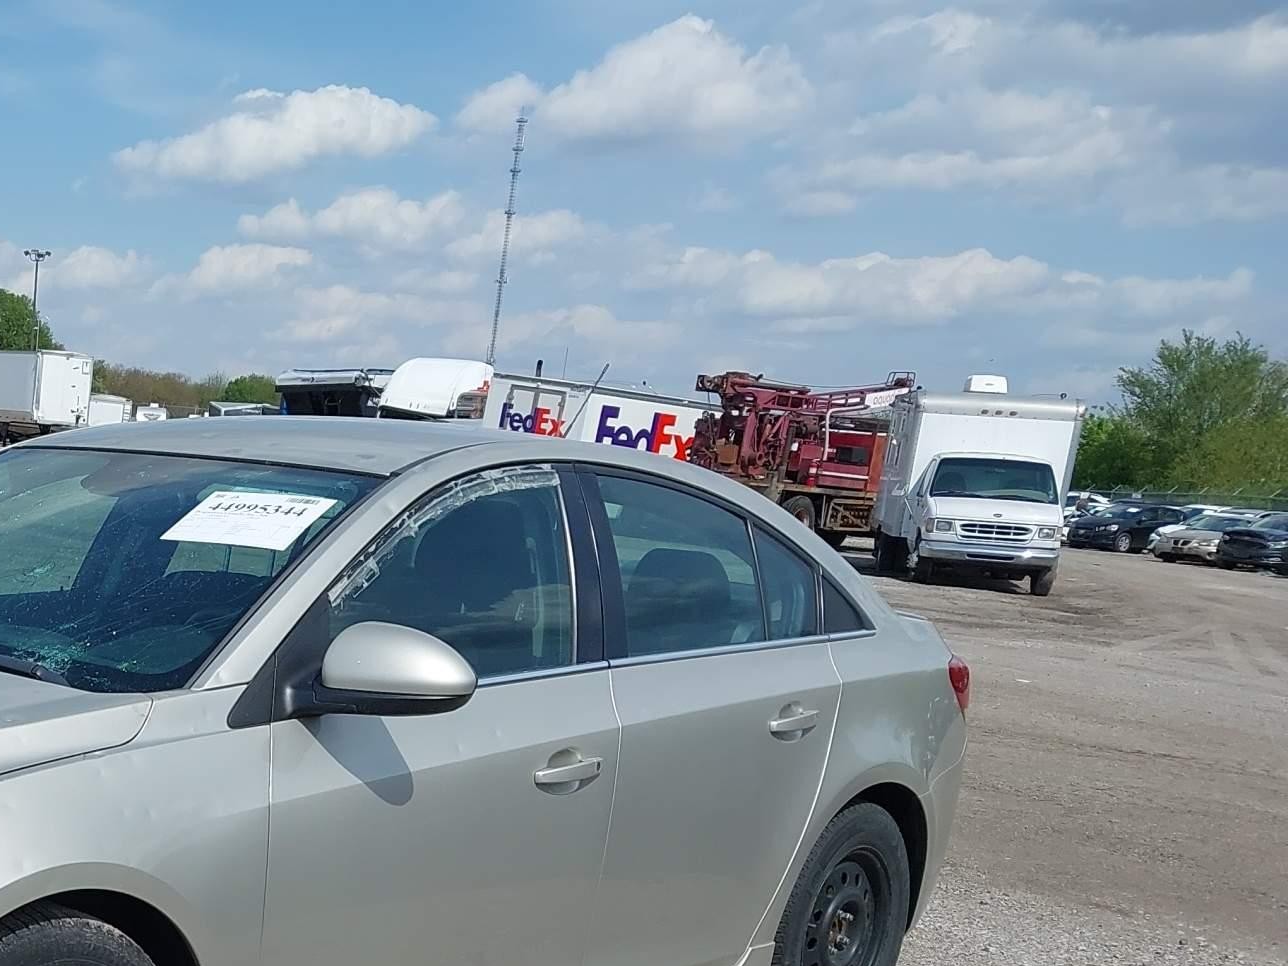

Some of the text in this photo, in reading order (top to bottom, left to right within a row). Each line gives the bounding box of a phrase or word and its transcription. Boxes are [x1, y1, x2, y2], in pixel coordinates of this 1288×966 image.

[498, 402, 565, 438] FedEx
[595, 405, 695, 462] FedEx
[208, 501, 308, 518] 44995344
